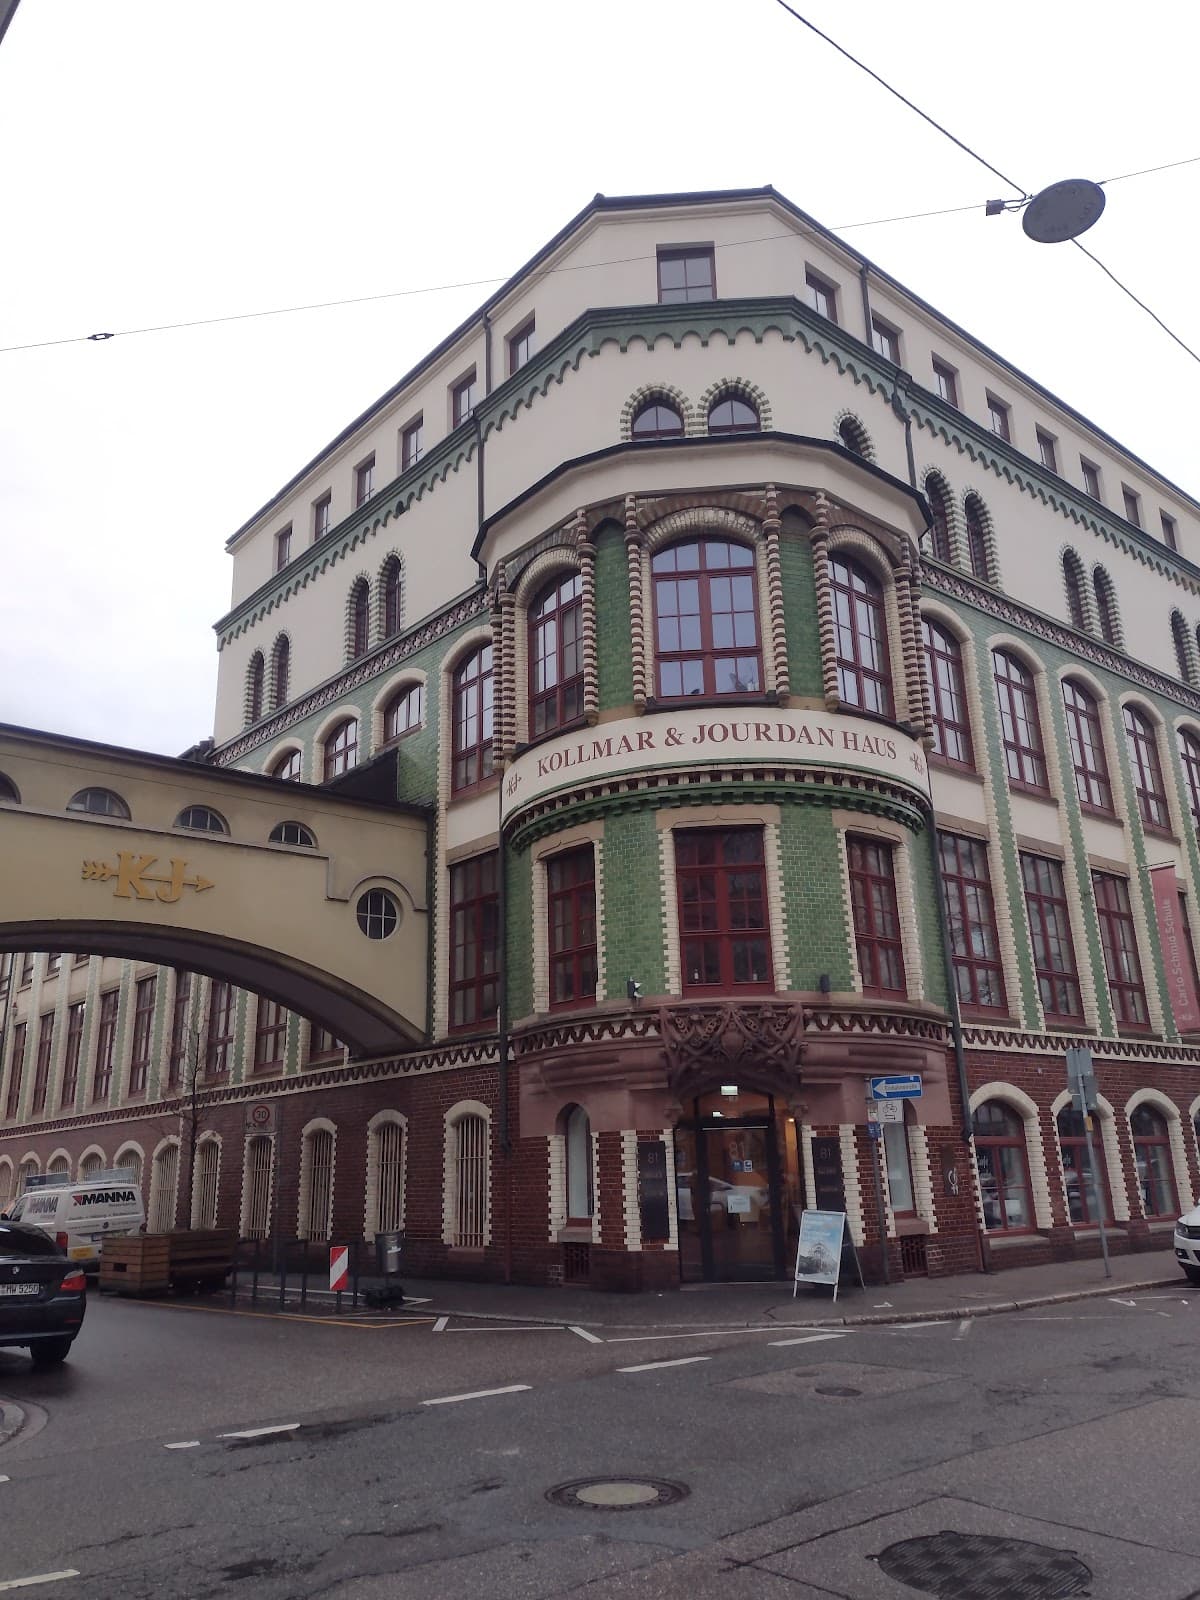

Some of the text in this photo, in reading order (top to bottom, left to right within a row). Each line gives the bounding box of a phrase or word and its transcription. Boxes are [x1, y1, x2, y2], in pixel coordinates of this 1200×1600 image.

[537, 721, 897, 777] KOLLMAR & JOURDAN HAUS
[113, 850, 187, 903] KJ
[1167, 935, 1182, 976] Schmid
[1176, 976, 1189, 1007] Carlo
[256, 1110, 267, 1119] 30
[647, 1152, 659, 1164] 81
[819, 1147, 831, 1160] 81
[82, 1190, 136, 1206] MANNA
